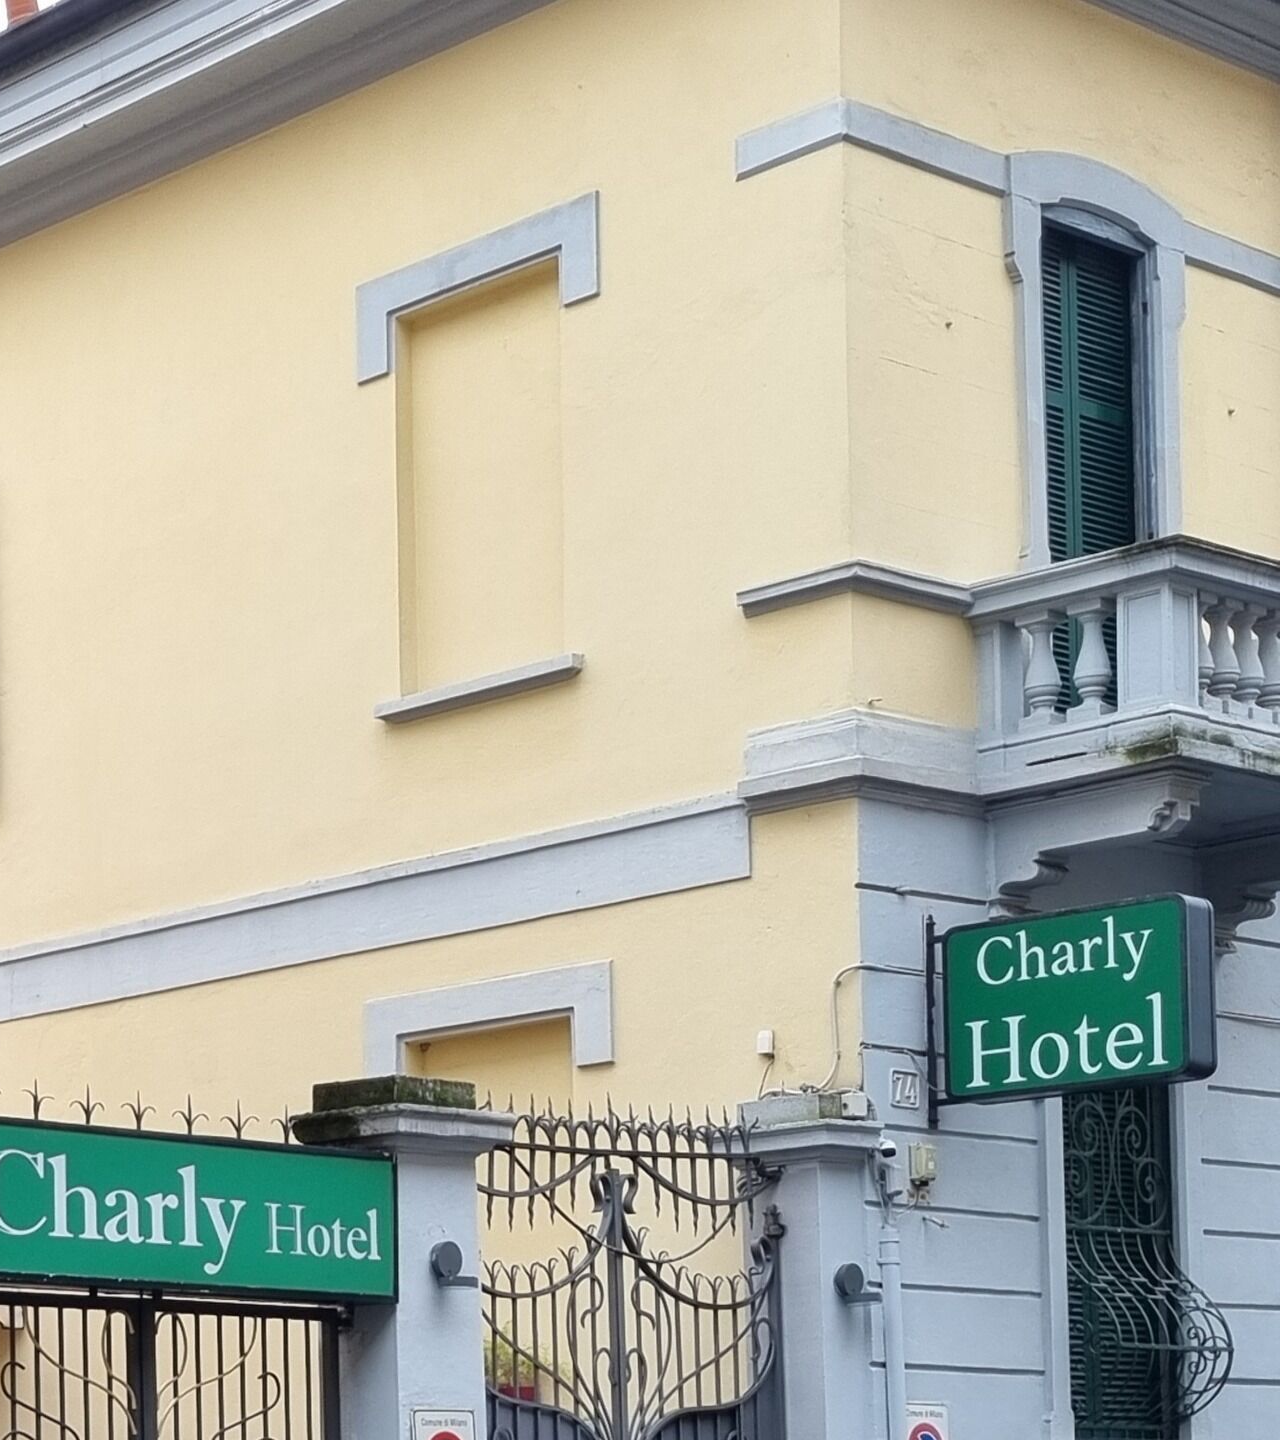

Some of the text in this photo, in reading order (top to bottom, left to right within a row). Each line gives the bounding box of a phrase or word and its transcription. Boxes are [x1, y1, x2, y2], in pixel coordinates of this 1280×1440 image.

[976, 915, 1153, 985] Charly
[964, 991, 1169, 1089] Hotel
[893, 1072, 917, 1104] 74
[264, 1202, 382, 1261] Hotel
